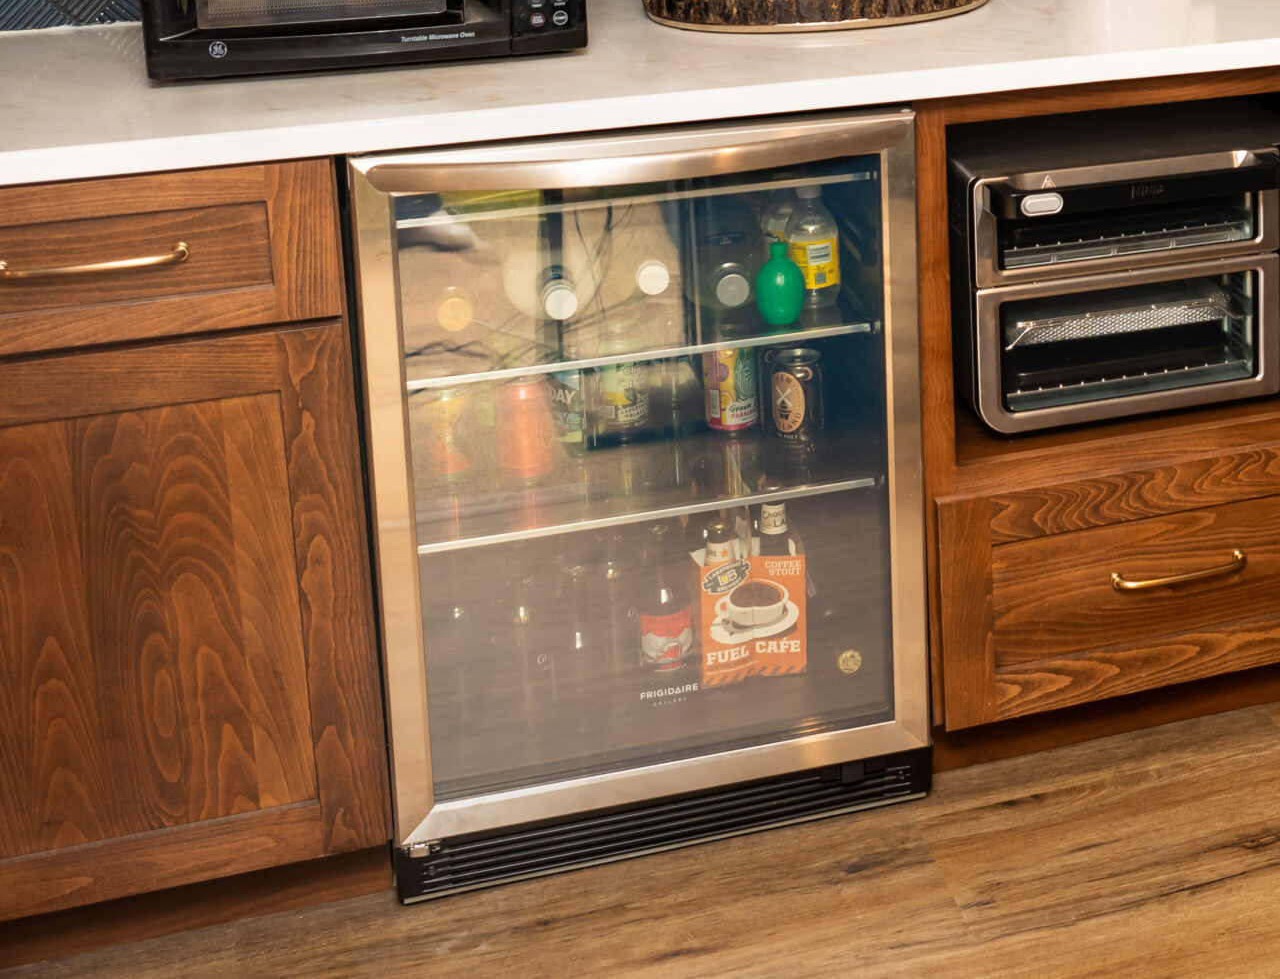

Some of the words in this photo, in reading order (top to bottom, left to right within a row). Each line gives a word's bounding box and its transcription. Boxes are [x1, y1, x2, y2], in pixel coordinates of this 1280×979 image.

[765, 560, 801, 568] COFFEE
[769, 568, 801, 576] STOUT
[706, 646, 749, 665] FUEL
[640, 683, 699, 701] FRIGIDAIRE
